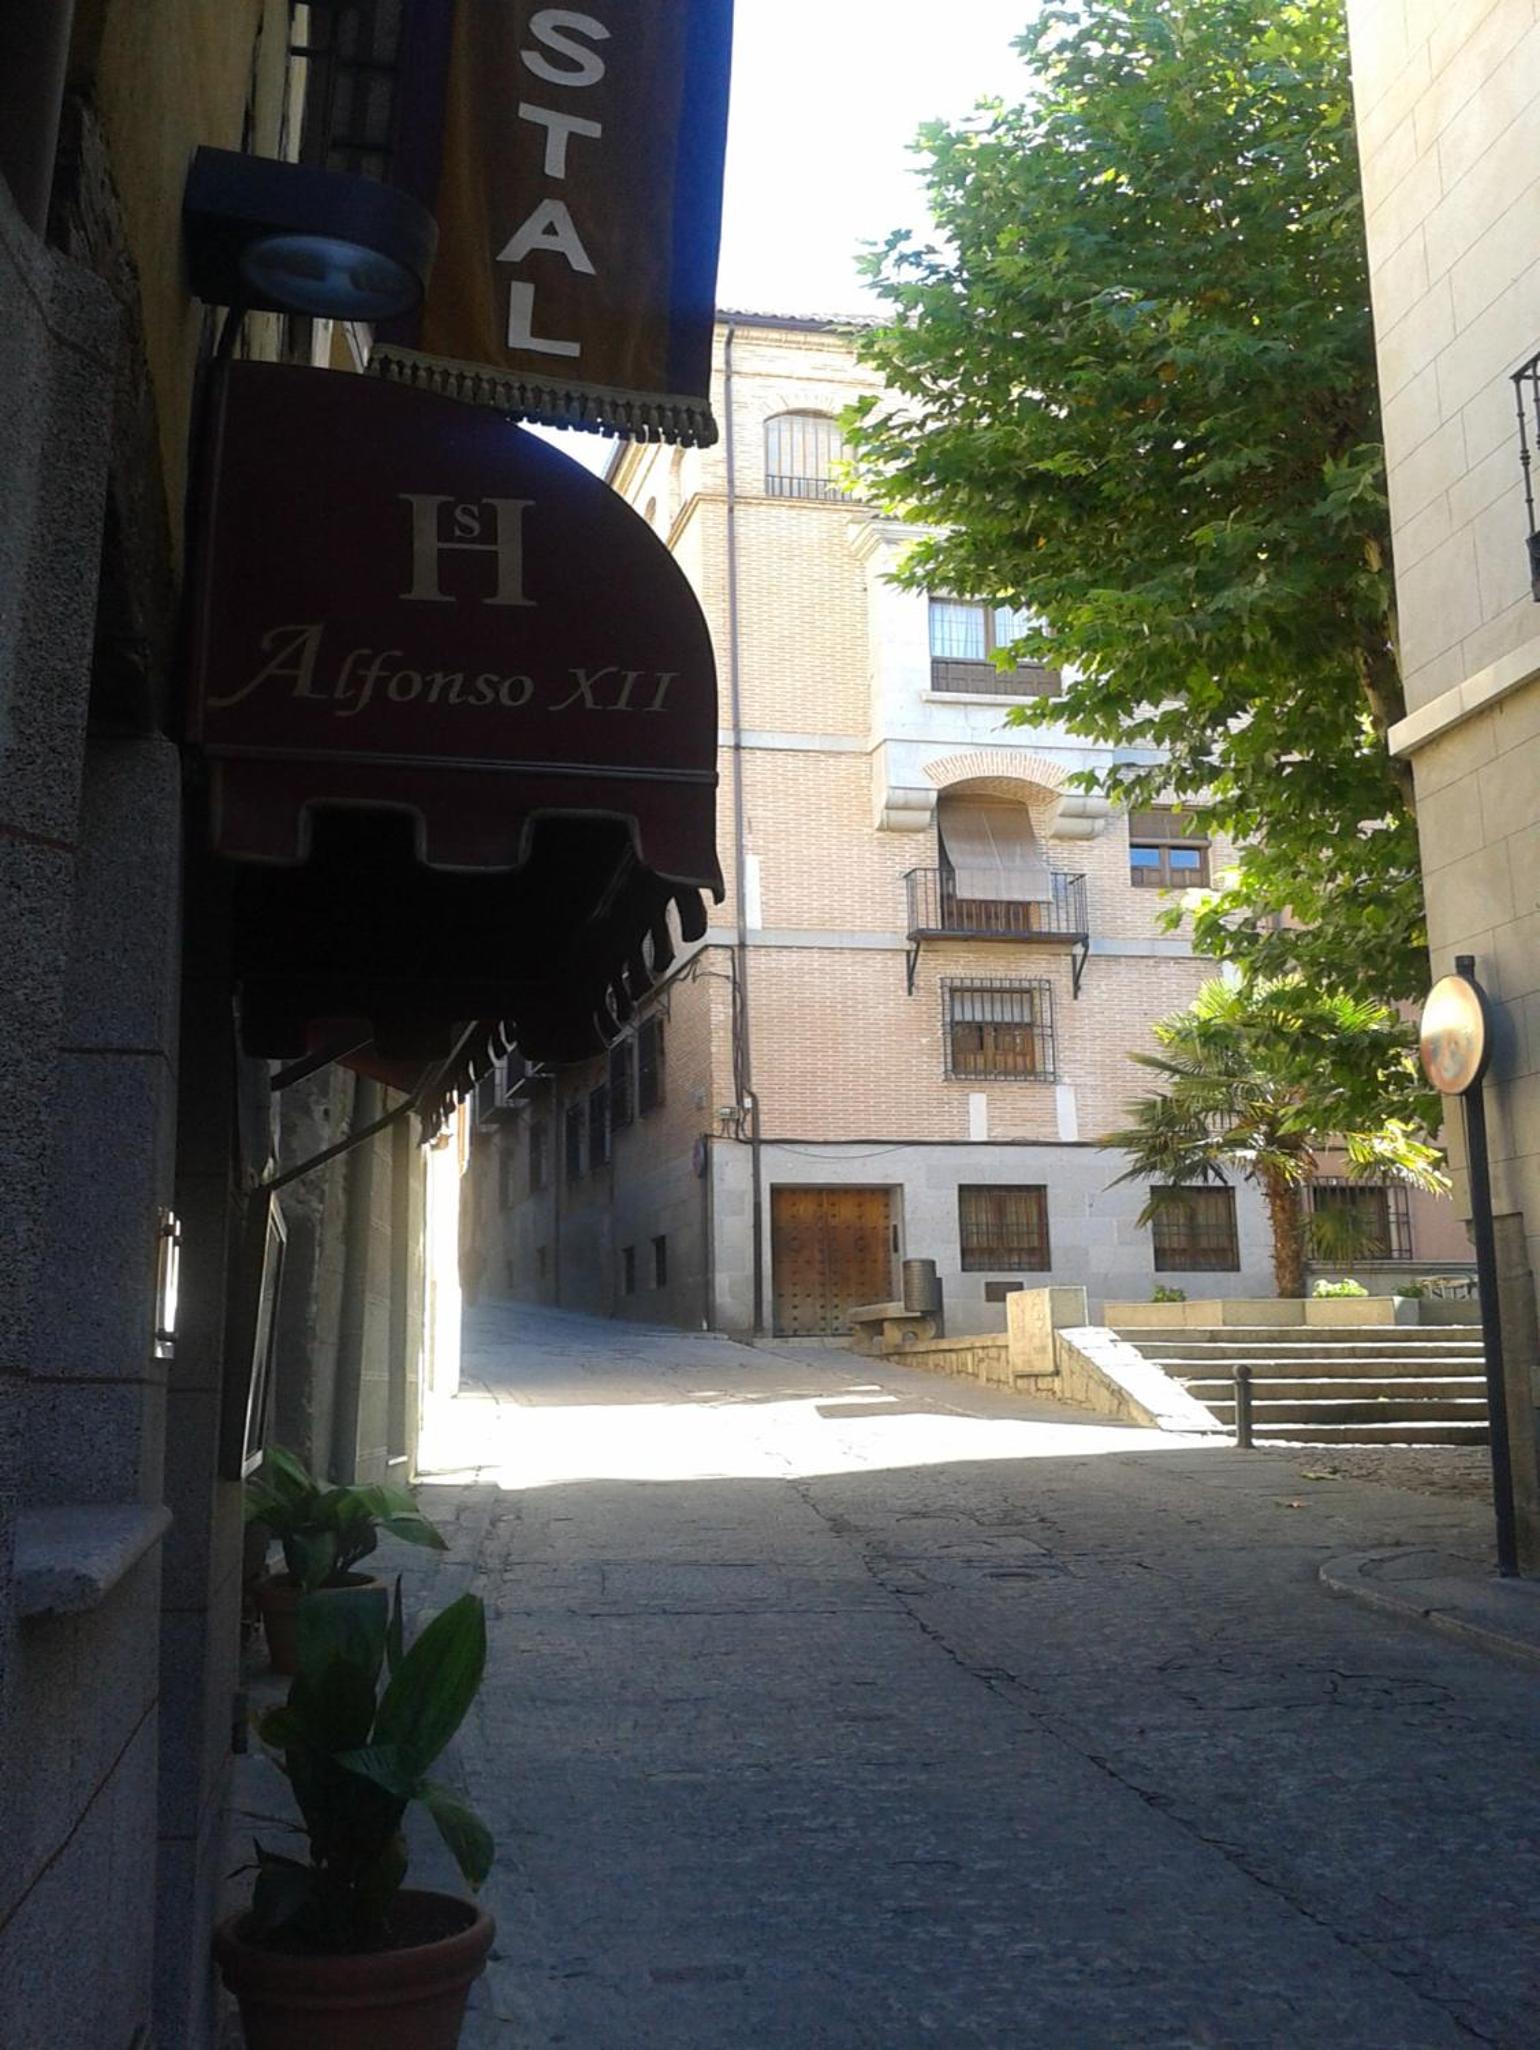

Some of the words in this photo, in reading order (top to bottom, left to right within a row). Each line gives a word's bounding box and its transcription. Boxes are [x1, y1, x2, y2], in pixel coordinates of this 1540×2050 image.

[496, 8, 613, 358] STAL
[206, 621, 535, 718] Alfonso
[547, 665, 681, 713] XII
